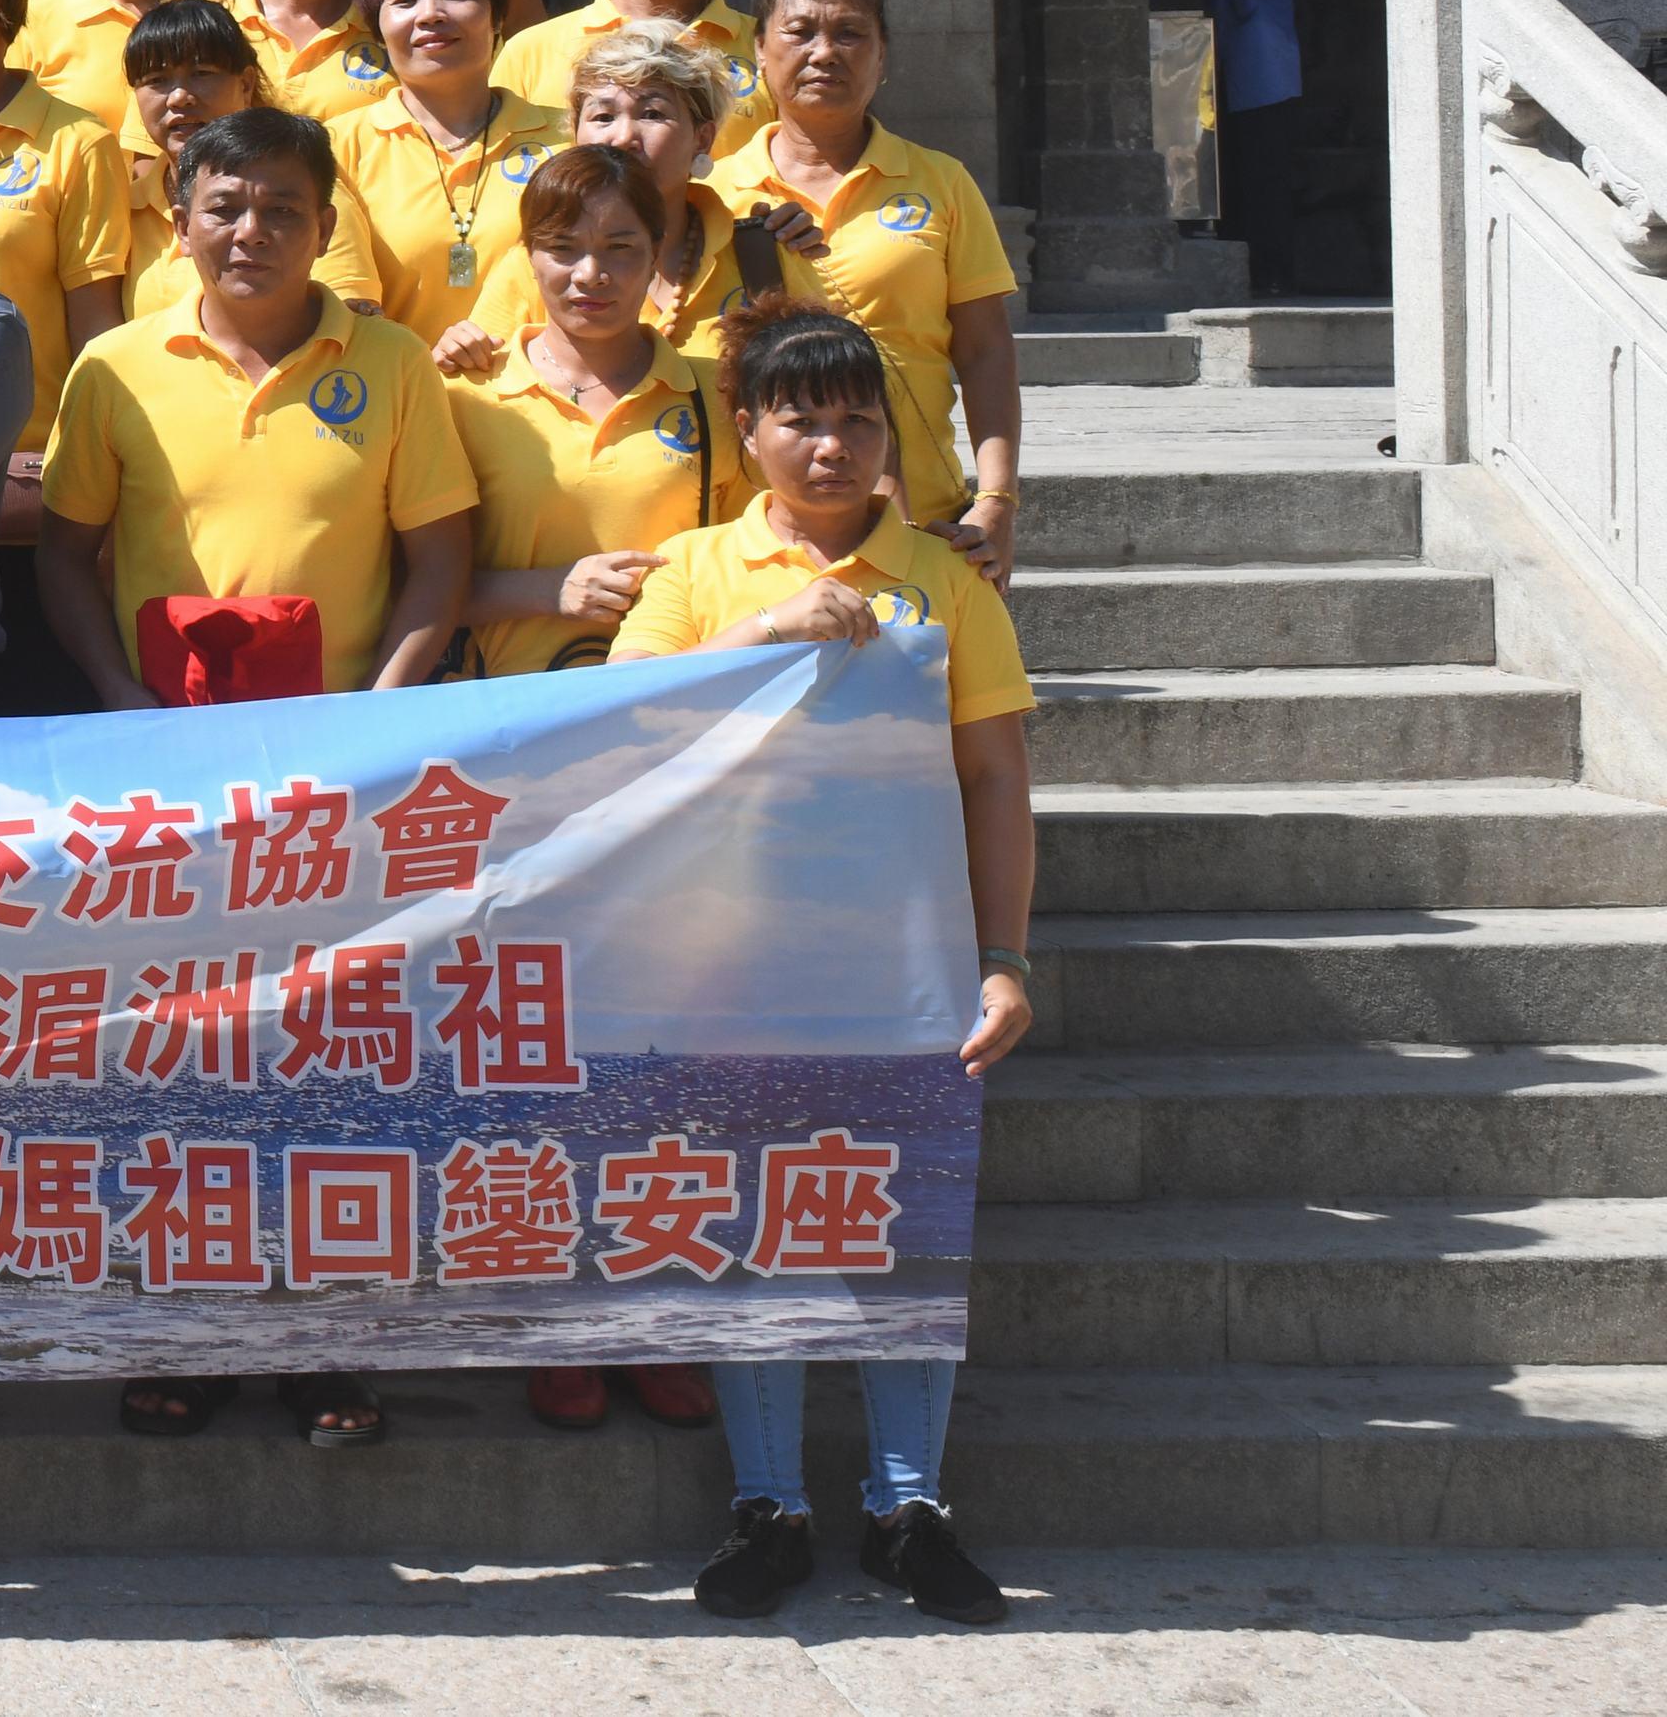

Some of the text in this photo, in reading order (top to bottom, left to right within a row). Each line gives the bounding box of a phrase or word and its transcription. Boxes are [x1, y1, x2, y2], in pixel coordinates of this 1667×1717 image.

[346, 81, 387, 97] MAZU
[888, 232, 932, 247] MAZU
[314, 425, 364, 446] MAZU
[662, 450, 702, 476] MAZU
